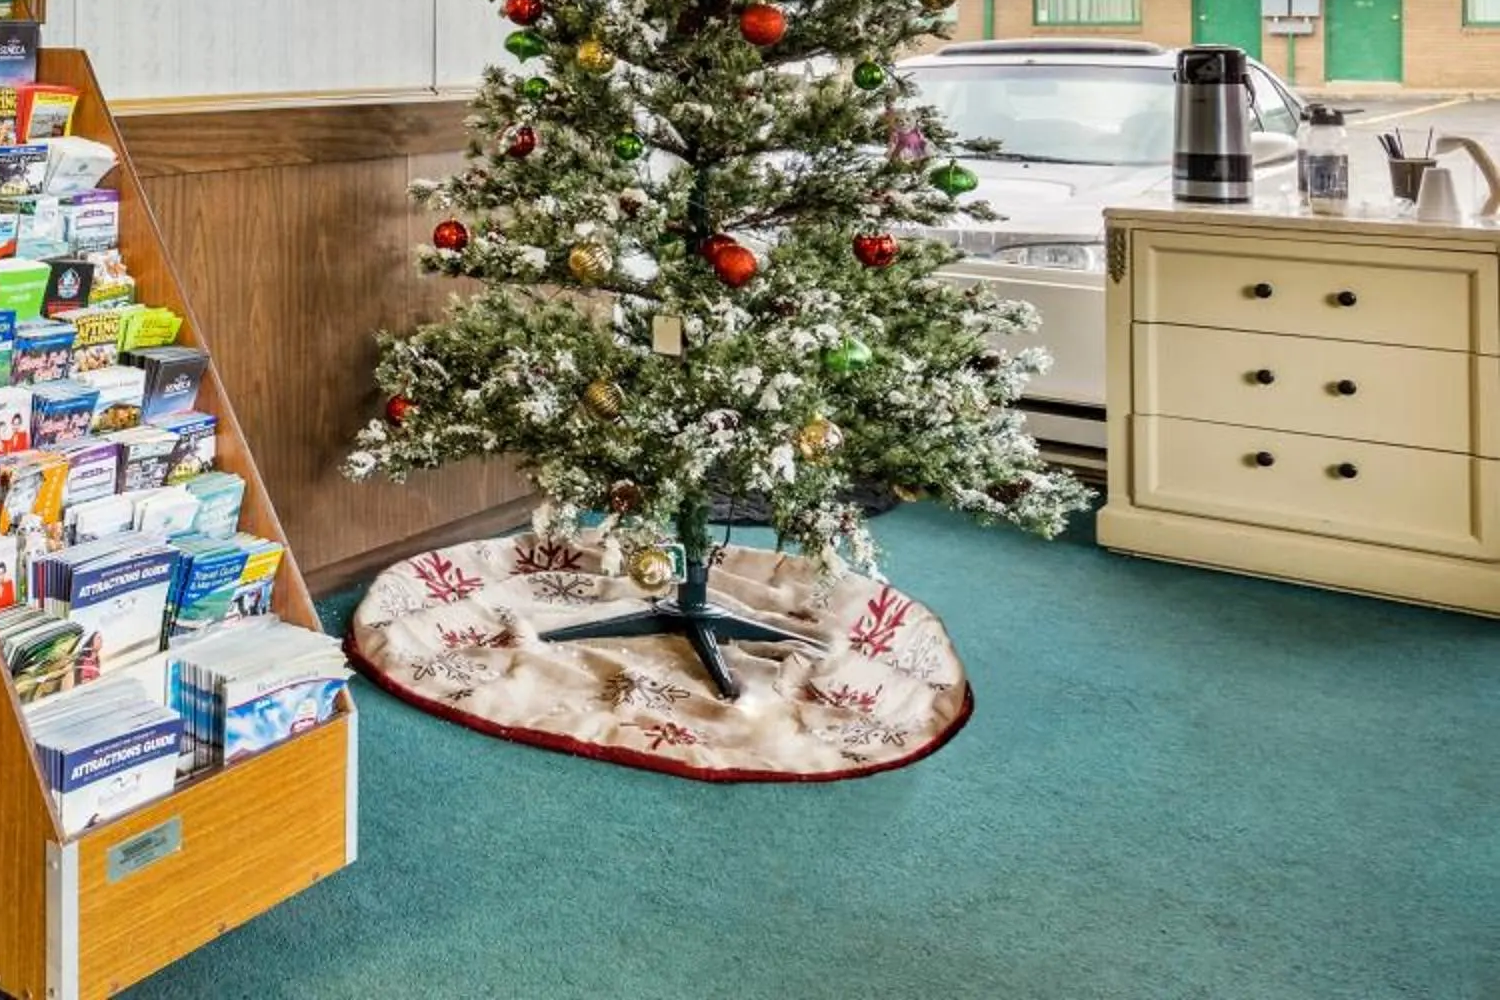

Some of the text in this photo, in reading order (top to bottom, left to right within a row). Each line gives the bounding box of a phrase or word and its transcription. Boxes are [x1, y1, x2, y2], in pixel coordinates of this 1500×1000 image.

[78, 569, 141, 598] ATTRACTIONS
[141, 563, 171, 580] GUIDE
[219, 564, 242, 577] Guide
[71, 743, 142, 780] ATTRACTIONS
[143, 732, 177, 753] GUIDE
